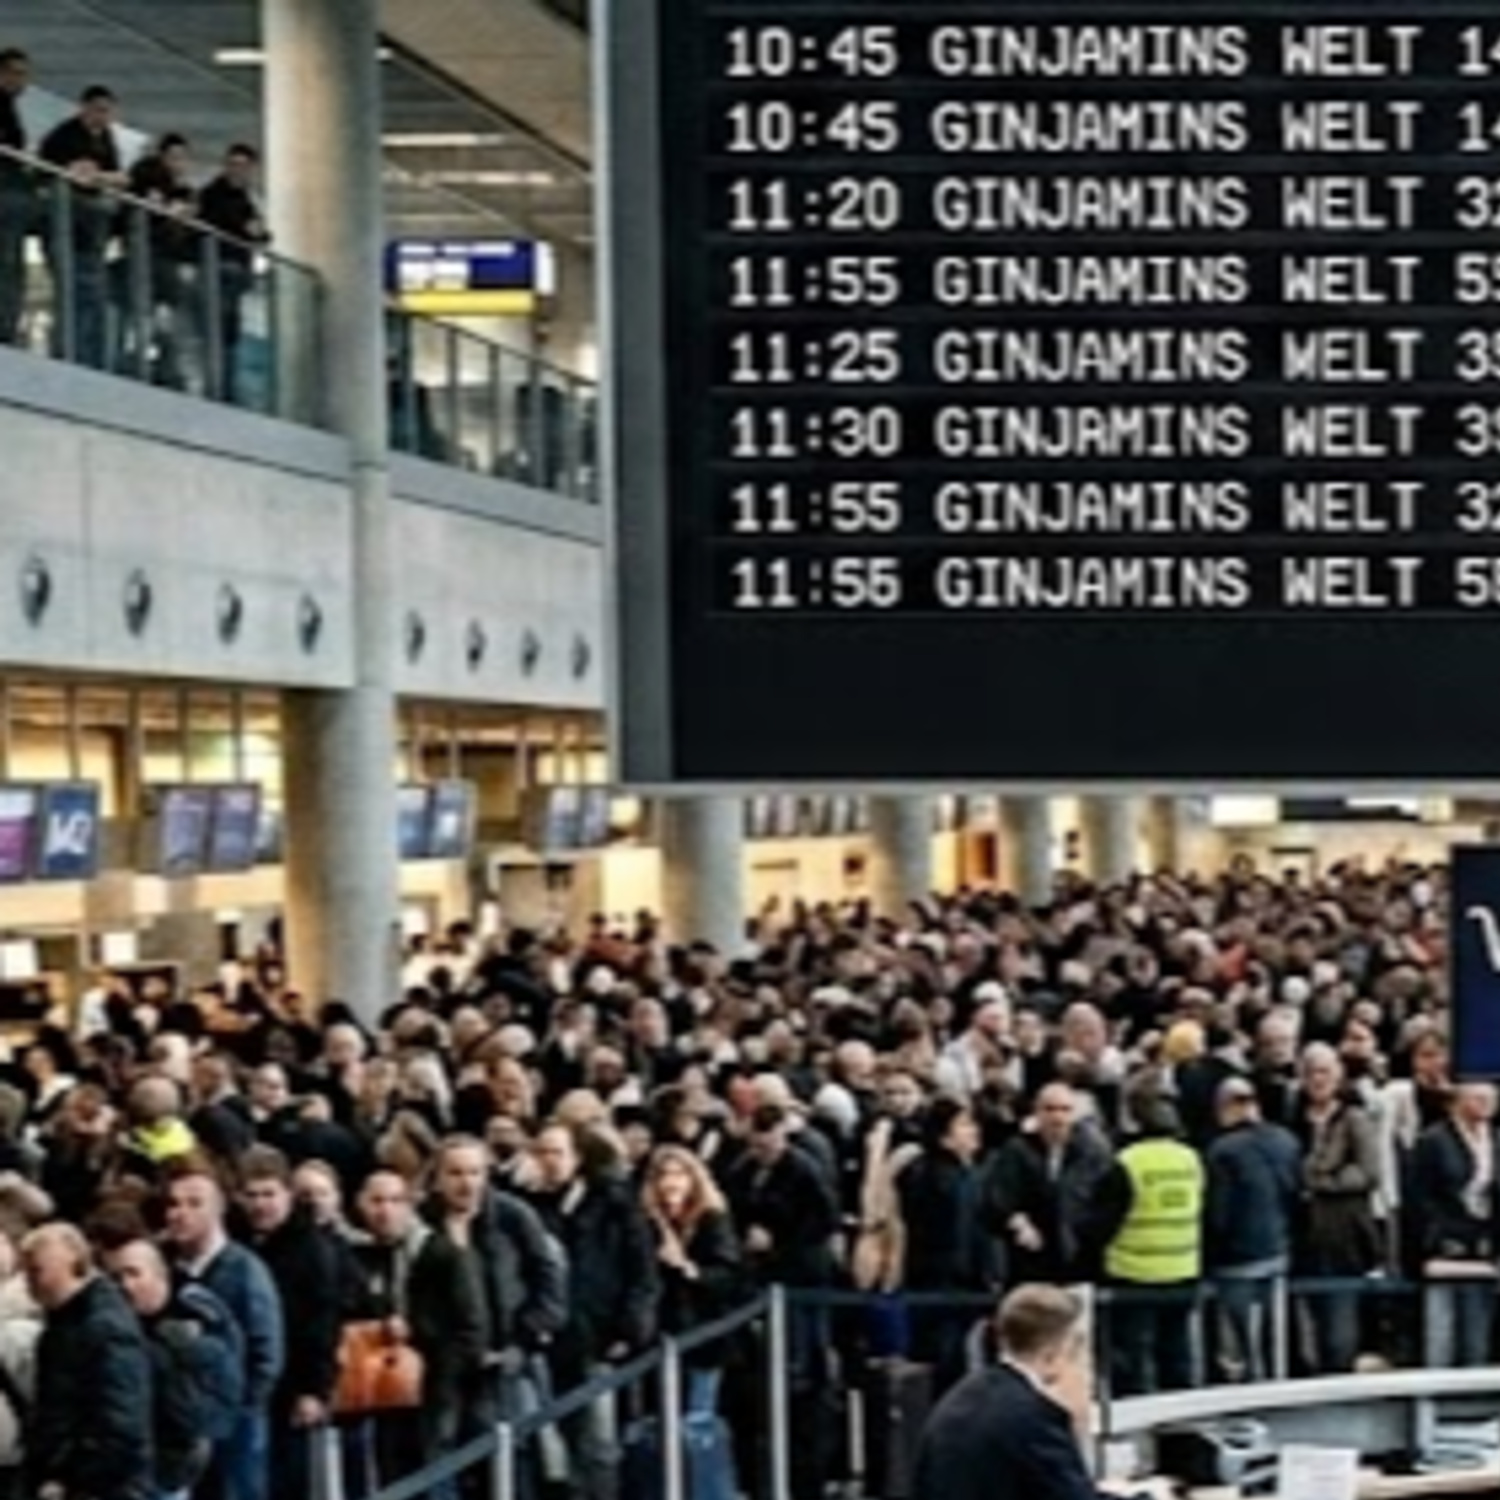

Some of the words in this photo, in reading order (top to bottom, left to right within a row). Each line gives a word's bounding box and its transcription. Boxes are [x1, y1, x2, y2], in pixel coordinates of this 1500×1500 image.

[726, 25, 898, 75] 10:45
[931, 25, 1249, 75] GINJAMINS
[1282, 25, 1422, 75] WELT
[727, 101, 898, 151] 10:45
[931, 101, 1249, 151] GINJAMINS
[1282, 101, 1422, 151] WELT
[729, 176, 898, 228] 11:20
[933, 176, 1249, 228] GINJAMINS
[1282, 176, 1422, 228] WELT
[731, 254, 898, 304] 11:55
[934, 254, 1249, 304] GINJAMINS
[1282, 254, 1422, 304] WELT
[731, 330, 898, 381] 11:25
[934, 330, 1249, 381] GINJAMINS
[1282, 330, 1422, 381] WELT
[733, 405, 898, 456] 11:30
[1282, 405, 1422, 456] WELT
[732, 481, 898, 531] 11:55
[935, 481, 1249, 531] GINJAMINS
[1282, 481, 1422, 531] WELT
[936, 556, 1249, 606] GINJAMINS
[1282, 556, 1422, 606] WELT
